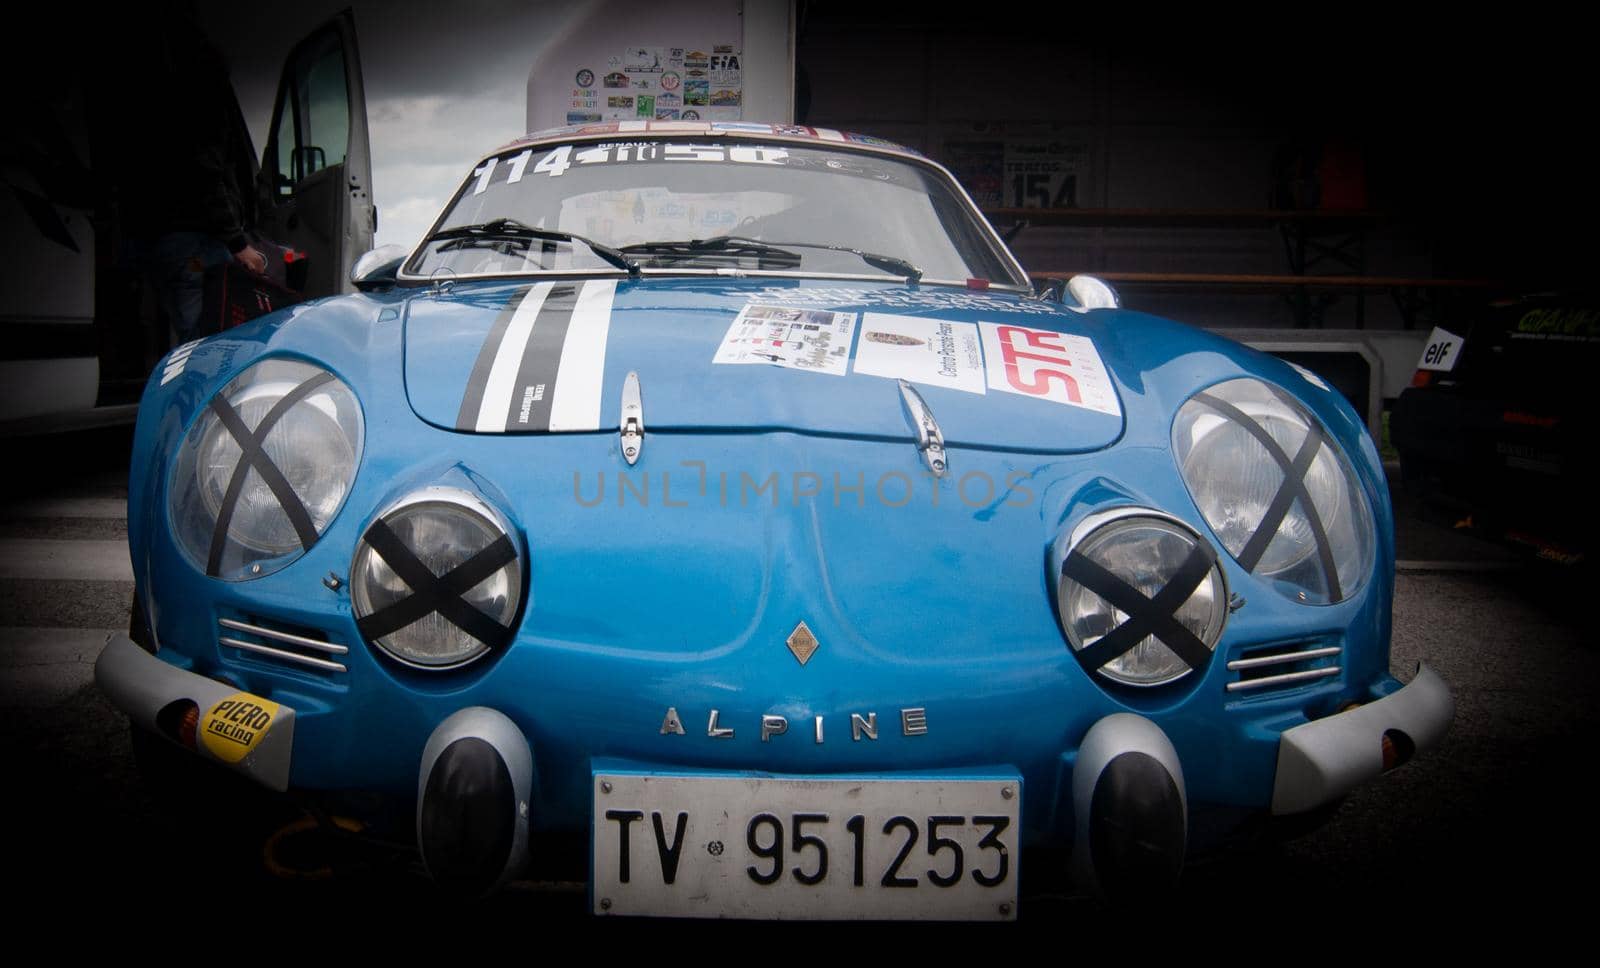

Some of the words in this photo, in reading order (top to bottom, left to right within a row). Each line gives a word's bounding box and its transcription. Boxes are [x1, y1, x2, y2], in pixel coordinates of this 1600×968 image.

[473, 145, 573, 195] 114
[1011, 173, 1077, 209] 154
[996, 326, 1082, 404] STR
[1424, 342, 1452, 365] elf
[208, 718, 255, 746] racing
[212, 699, 271, 731] PIERO
[659, 707, 929, 744] ALPINE
[605, 810, 689, 885] TV
[745, 812, 1010, 888] 951253
